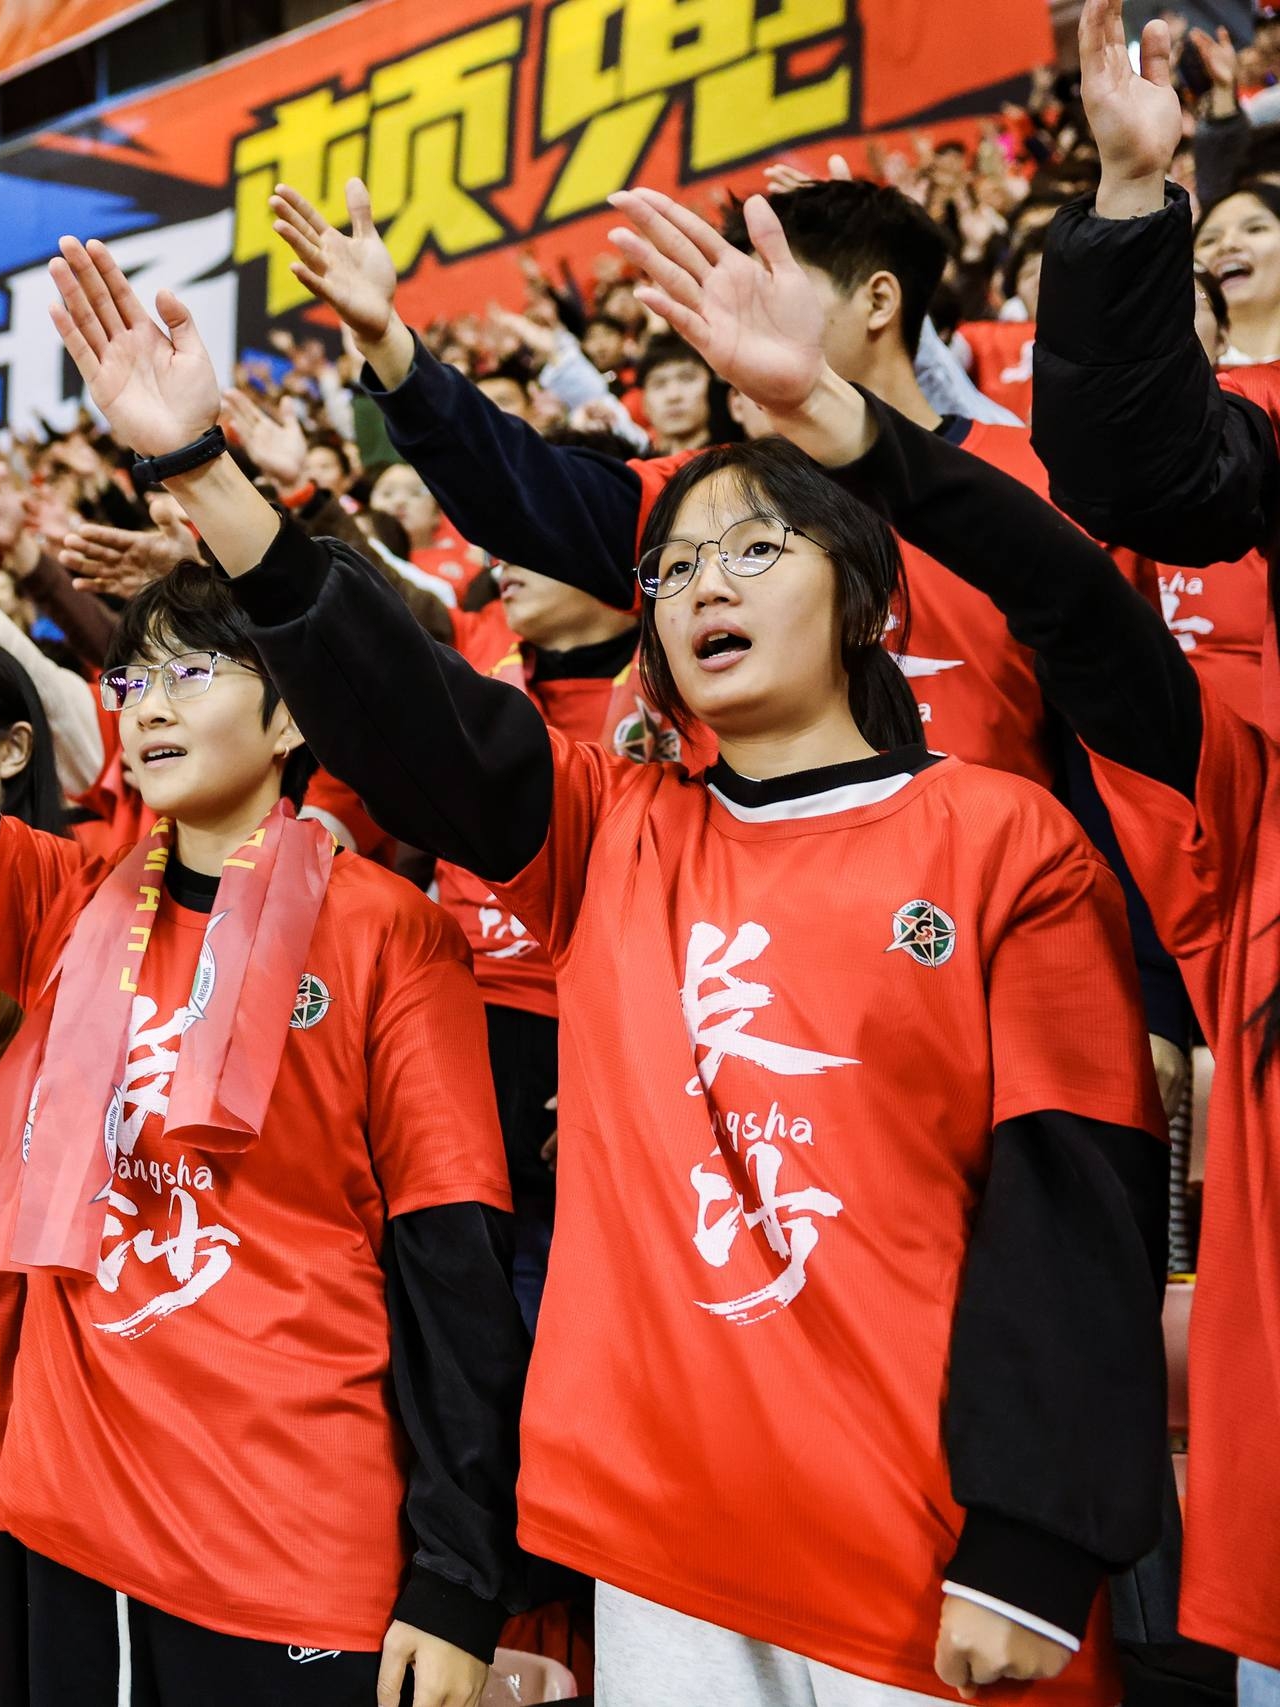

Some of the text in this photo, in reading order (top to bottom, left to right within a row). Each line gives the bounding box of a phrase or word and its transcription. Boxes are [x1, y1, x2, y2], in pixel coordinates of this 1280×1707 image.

[679, 921, 863, 1097] 长
[117, 1155, 214, 1194] angsha
[711, 1101, 815, 1154] ngsha
[88, 1186, 241, 1341] 沙
[687, 1141, 846, 1326] 沙
